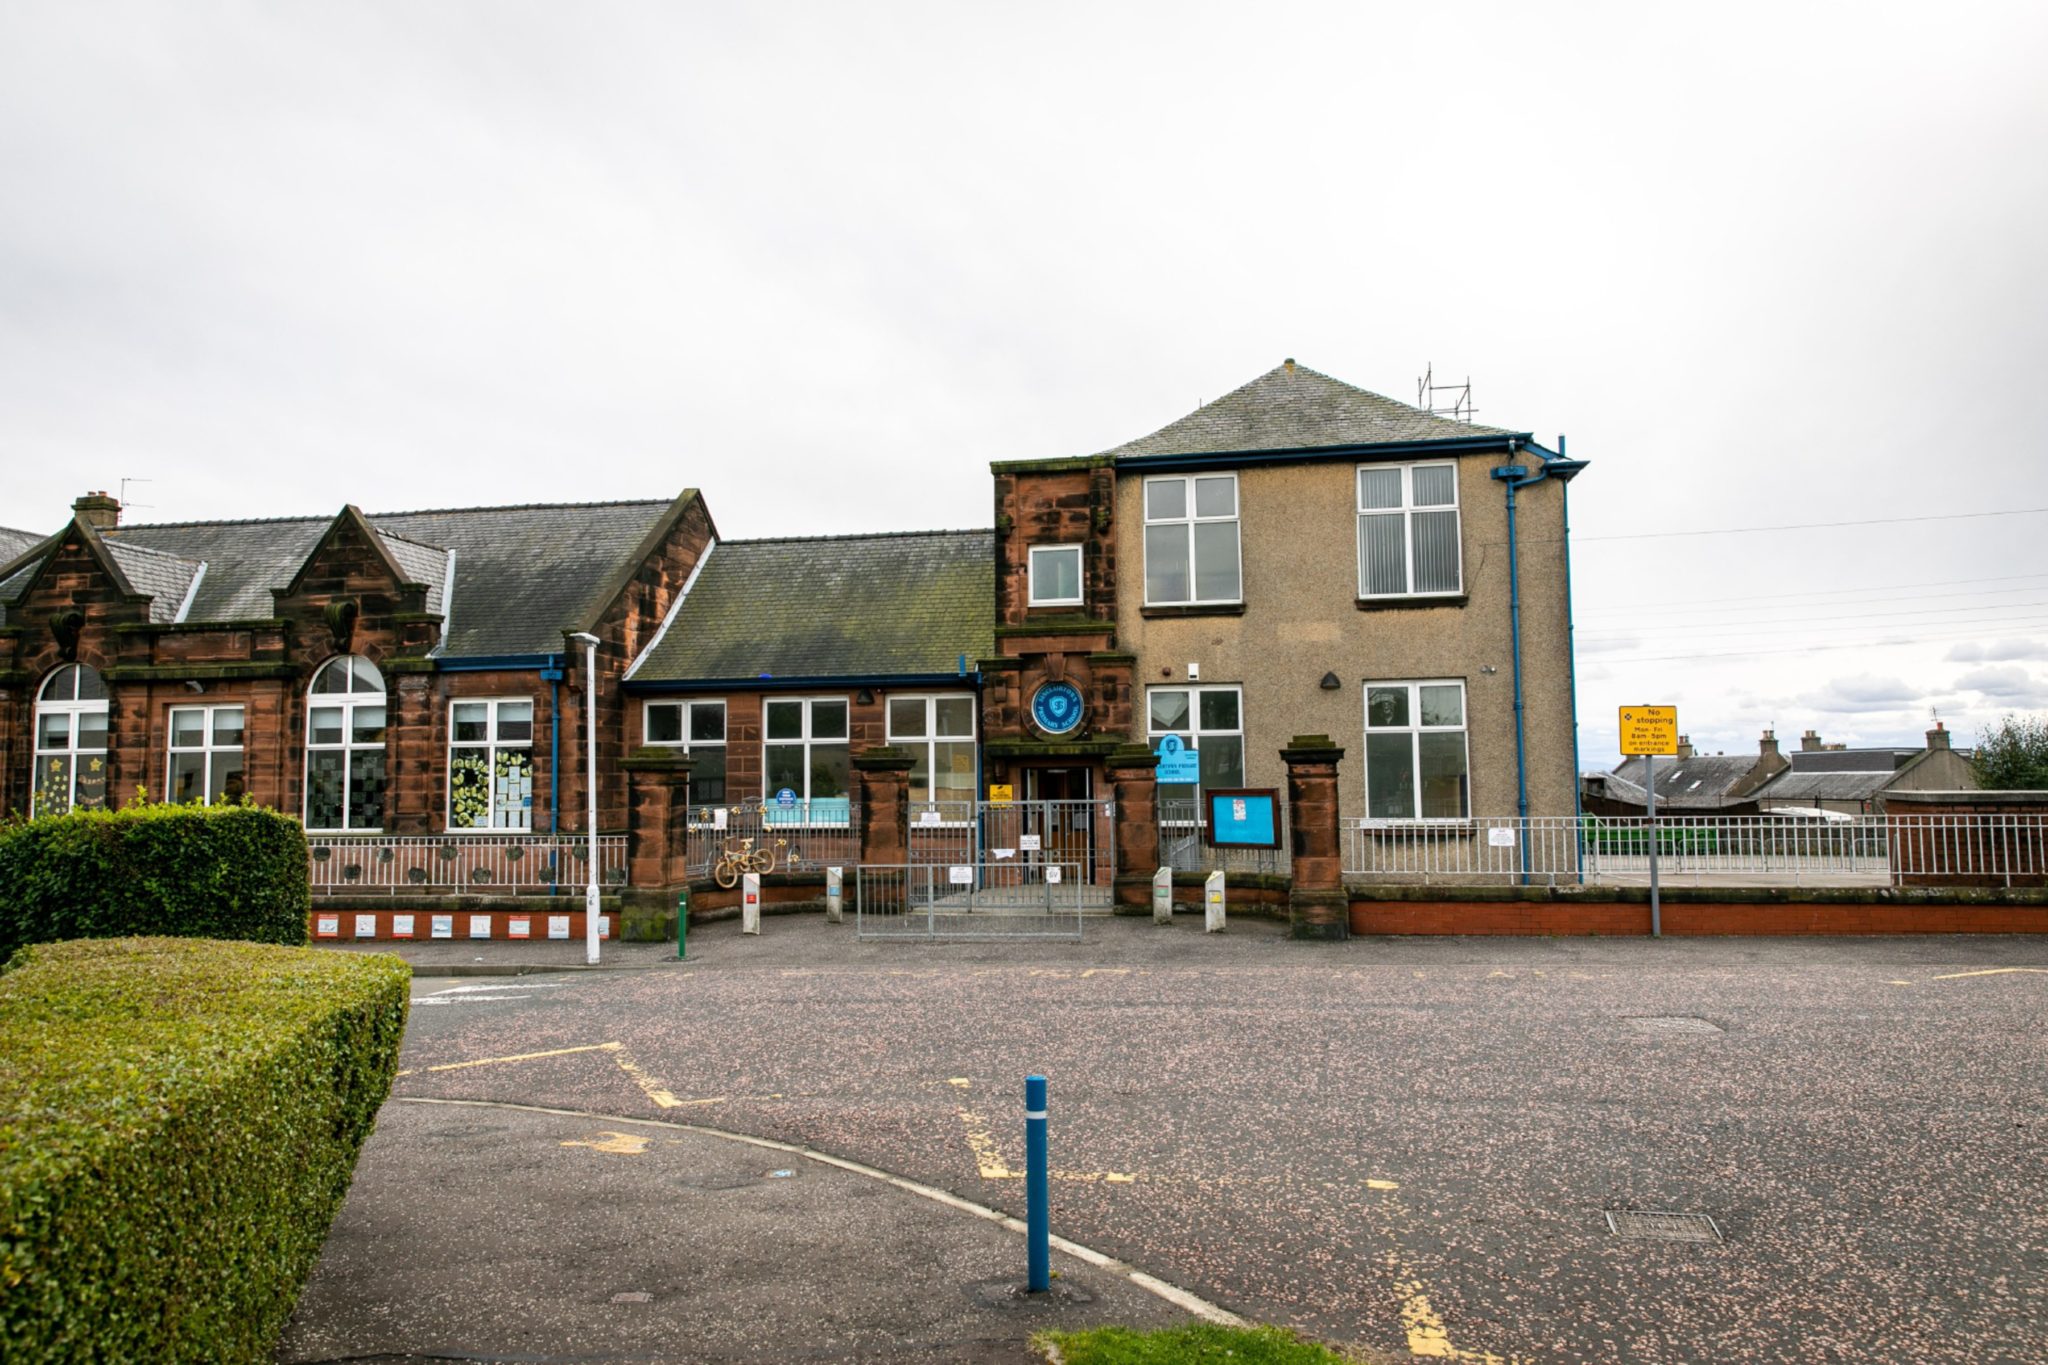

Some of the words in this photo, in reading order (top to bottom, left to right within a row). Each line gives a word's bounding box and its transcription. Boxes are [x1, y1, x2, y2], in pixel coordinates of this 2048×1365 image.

[1037, 706, 1058, 729] PRIMARY
[1062, 704, 1080, 728] SCHOOL
[1636, 717, 1673, 726] stopping
